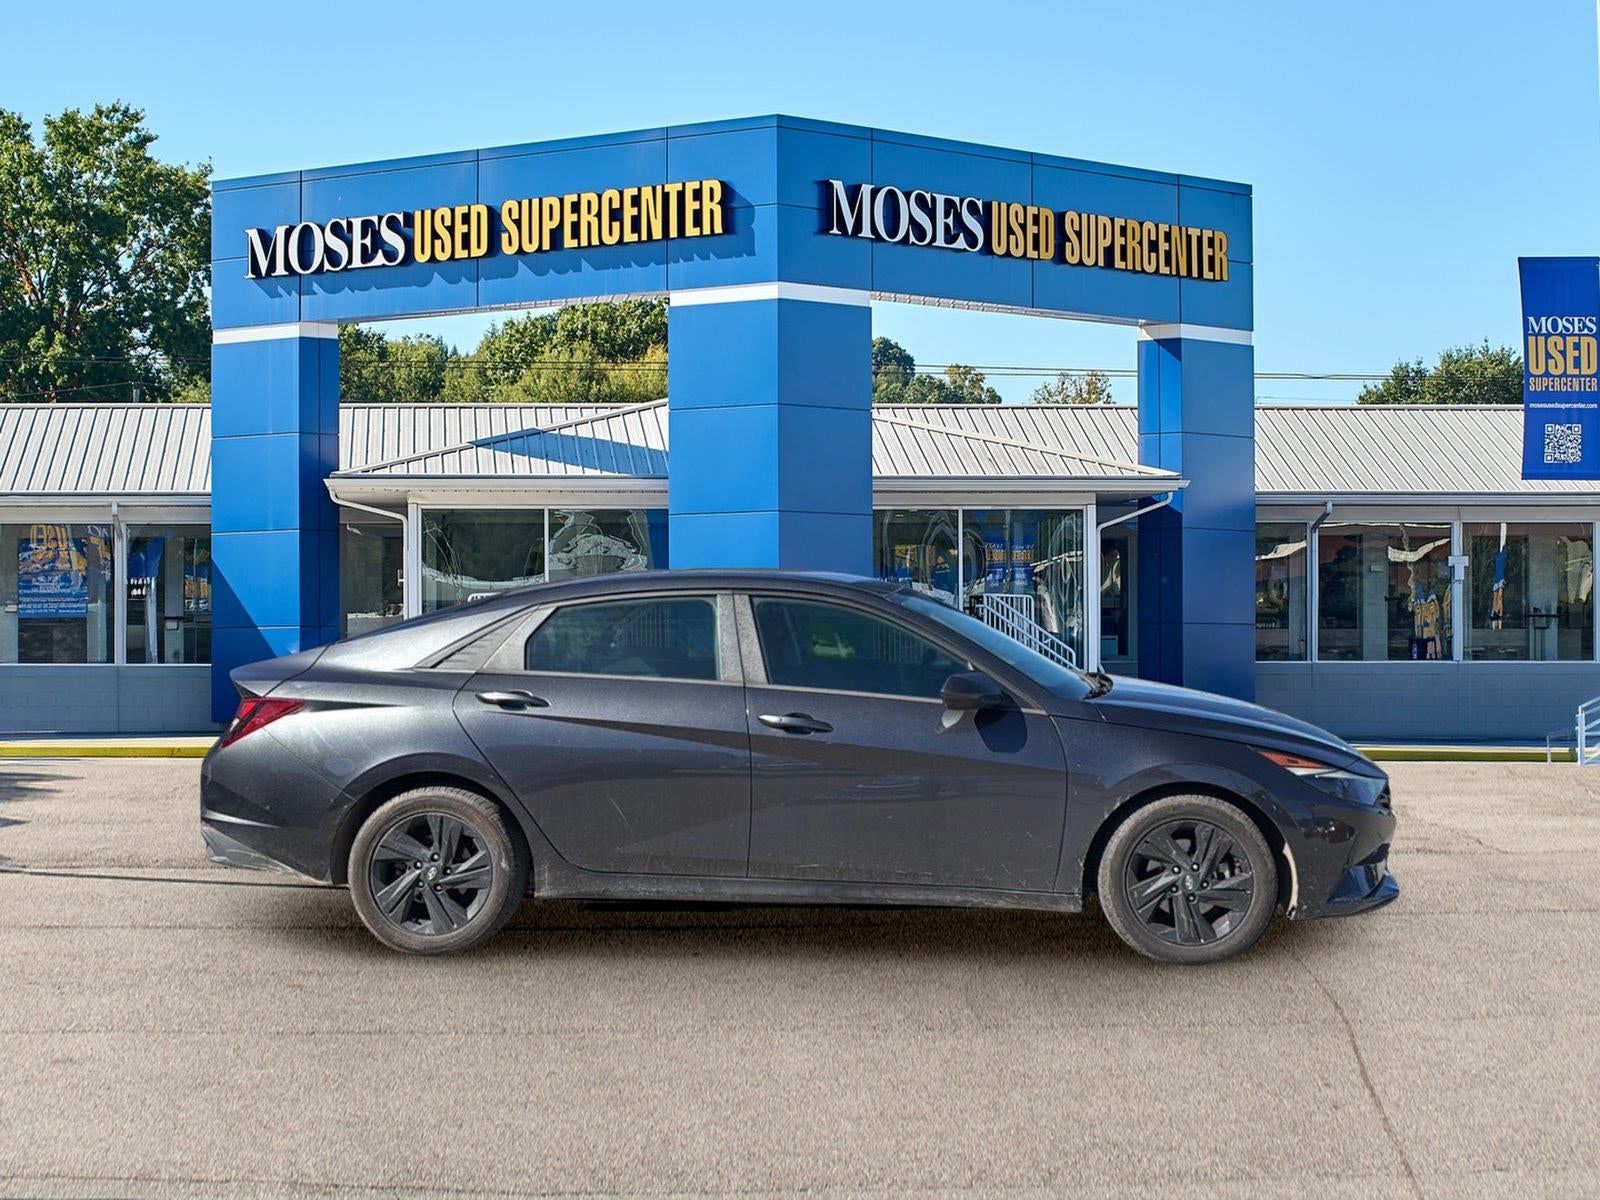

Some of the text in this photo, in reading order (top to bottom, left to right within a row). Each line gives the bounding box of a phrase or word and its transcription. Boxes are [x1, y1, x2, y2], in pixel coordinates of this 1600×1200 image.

[244, 178, 724, 279] MOSES USED SUPERCENTER
[828, 179, 1229, 282] MOSES USED SUPERCENTER
[1527, 316, 1597, 334] MOSES
[1528, 335, 1598, 375] USED
[1529, 377, 1598, 392] SUPERCENTER
